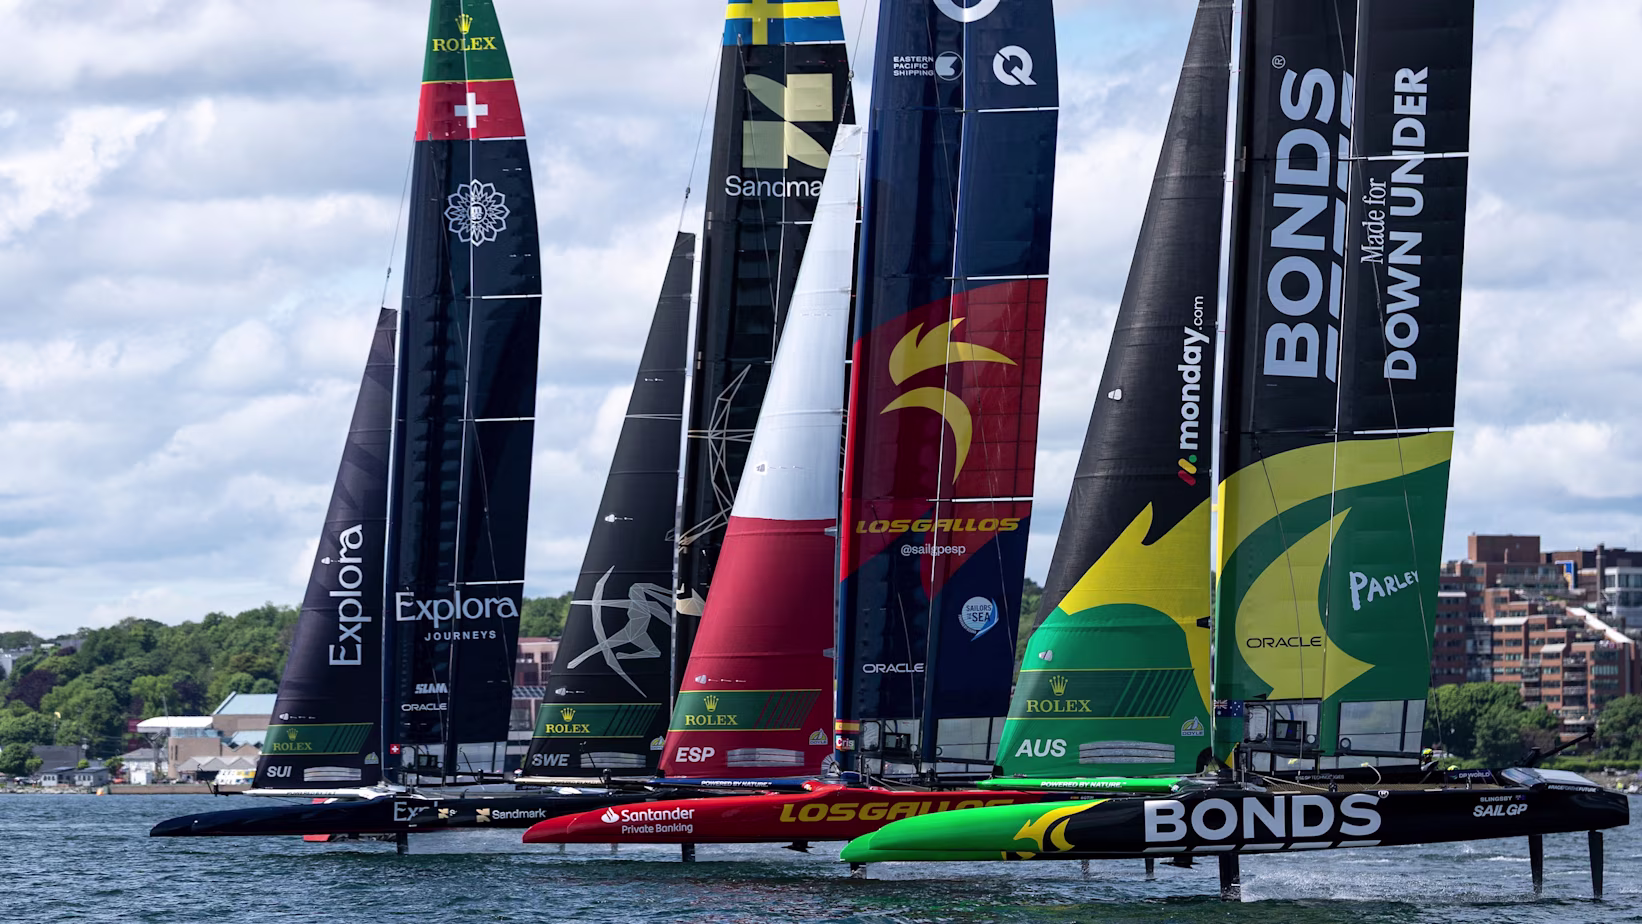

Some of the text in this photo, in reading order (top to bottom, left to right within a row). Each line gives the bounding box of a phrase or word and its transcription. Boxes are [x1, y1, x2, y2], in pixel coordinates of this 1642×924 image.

[432, 36, 498, 52] ROLEX
[724, 175, 823, 198] Sandma
[1360, 177, 1387, 265] Made for
[1383, 66, 1429, 381] DOWN UNDER
[1177, 296, 1210, 450] monday.com
[856, 517, 1021, 534] LOSGALLOS
[900, 543, 966, 557] @sailgpesp
[329, 523, 372, 666] Explora
[1349, 570, 1420, 611] PARLEY
[395, 590, 519, 629] Explora
[966, 604, 992, 612] SAILORS
[971, 612, 991, 622] SEA
[424, 630, 497, 642] JOURNEYS
[1246, 636, 1322, 649] ORACLE
[862, 662, 925, 674] ORACLE
[414, 683, 449, 694] SLAM
[401, 702, 448, 712] ORACLE
[1026, 699, 1093, 714] ROLEX
[684, 714, 738, 726] ROLEX
[545, 723, 591, 734] ROLEX
[273, 742, 313, 751] ROLEX
[1015, 738, 1068, 758] AUS
[531, 753, 571, 767] SWE
[675, 747, 716, 763] ESP
[266, 765, 293, 778] SUI
[492, 808, 547, 820] Sandmark
[621, 807, 695, 822] Santander
[621, 822, 694, 835] Private Banking
